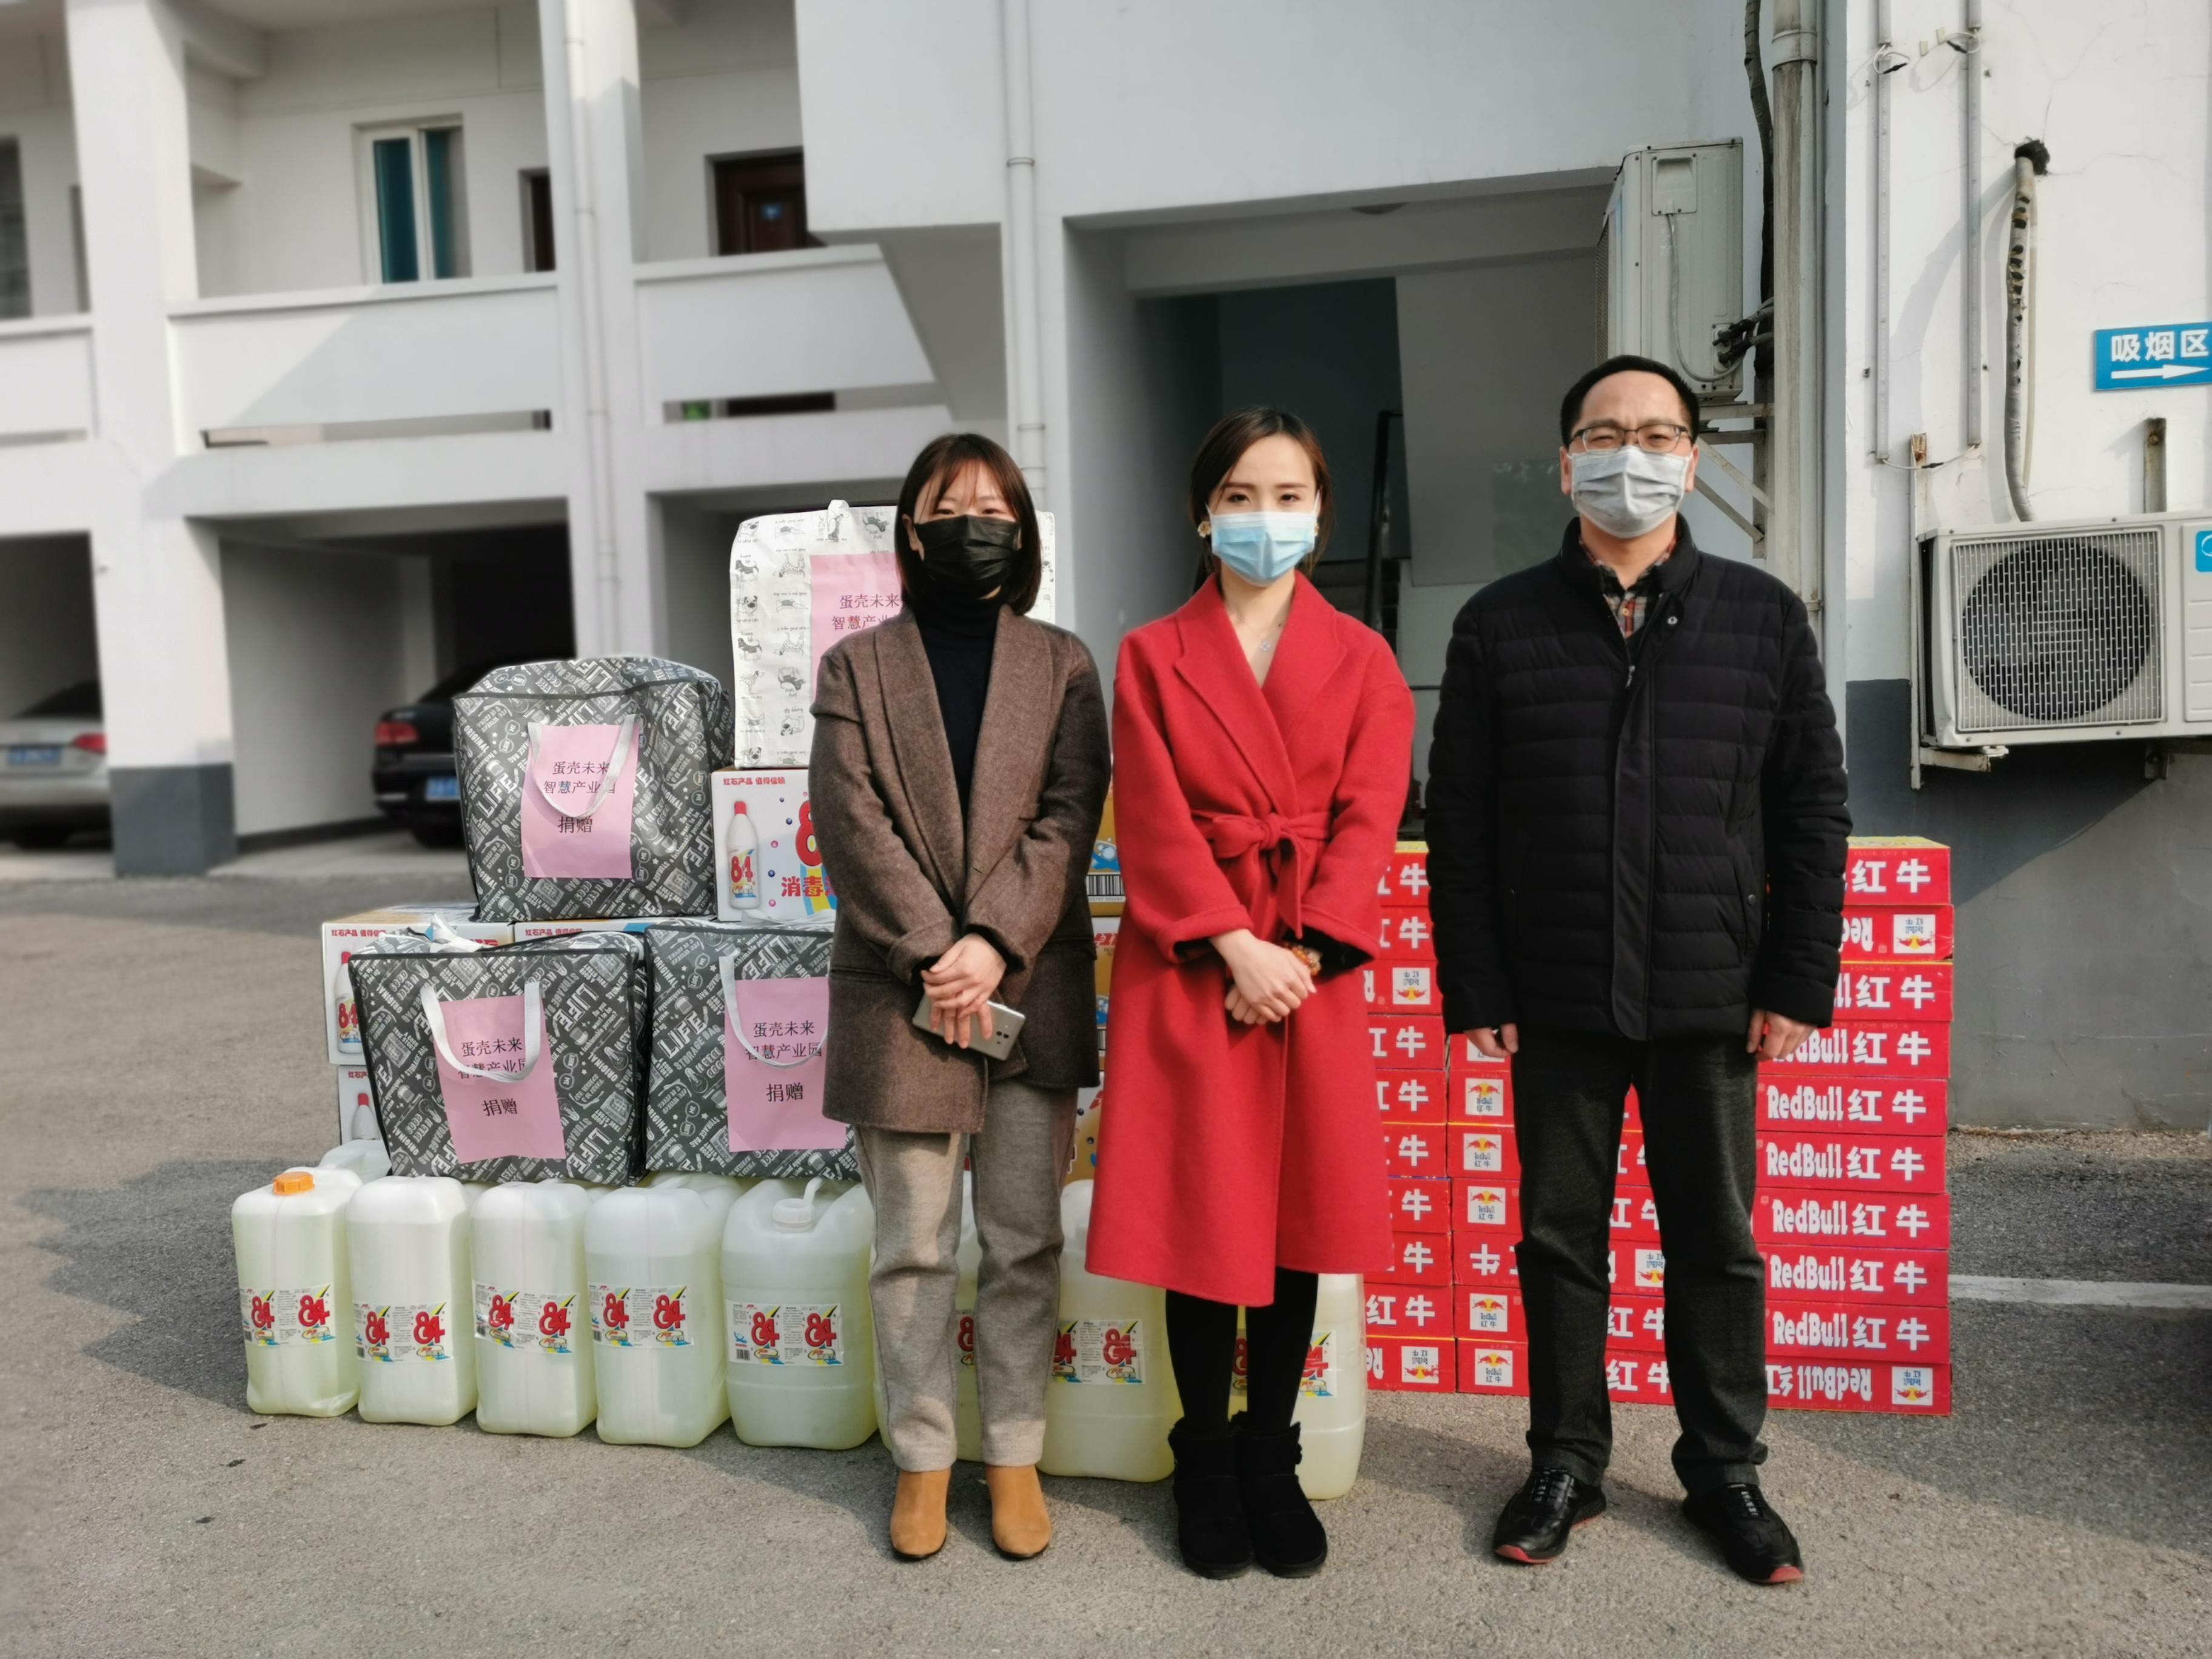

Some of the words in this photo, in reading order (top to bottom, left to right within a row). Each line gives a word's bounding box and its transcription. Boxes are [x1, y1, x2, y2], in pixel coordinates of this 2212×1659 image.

[2111, 329, 2210, 363] 吸烟区
[840, 593, 900, 609] 蛋壳未来
[833, 614, 896, 630] 智慧产业
[666, 683, 700, 731] LIFE
[463, 725, 490, 753] ORIGINAL
[552, 760, 610, 775] 蛋壳未来
[475, 773, 517, 819] LIFE
[558, 816, 593, 833] 捐赠
[730, 856, 754, 883] 84
[1377, 863, 1429, 896] 牛
[1851, 858, 1931, 894] 红牛
[653, 956, 679, 988] ORIGINAL
[743, 935, 792, 980] LIFE
[376, 983, 403, 1014] ORIGINAL
[551, 973, 580, 1010] STORAGE
[552, 982, 600, 1032] LIFE
[1855, 974, 1935, 1010] 红牛
[657, 1010, 707, 1059] LIFE
[753, 1020, 814, 1038] 蛋壳未来
[461, 1036, 523, 1057] 蛋壳未来
[673, 1036, 705, 1070] STORAGE
[745, 1042, 822, 1061] 智慧产业园
[1773, 1028, 1848, 1064] dBull
[1852, 1031, 1931, 1066] 红牛
[588, 1052, 618, 1082] ORIGINAL
[483, 1098, 517, 1116] 捐赠
[766, 1082, 803, 1102] 捐赠
[1766, 1085, 1843, 1121] RedBull
[1847, 1089, 1926, 1124] 红牛
[647, 1105, 671, 1136] ORIGINAL
[699, 1116, 720, 1141] STORAGE
[392, 1125, 419, 1156] ORIGINAL
[566, 1127, 612, 1175] LIFE
[689, 1136, 702, 1148] BAG
[1766, 1142, 1843, 1179] RedBull
[1846, 1146, 1925, 1181] 红牛
[1772, 1199, 1848, 1235] RedBull
[1851, 1203, 1929, 1238] 红牛
[1769, 1255, 1846, 1292] RedBull
[1849, 1259, 1928, 1294] 红牛
[252, 1296, 275, 1329] 84
[298, 1295, 330, 1327] 84
[366, 1311, 390, 1345] 84
[414, 1311, 446, 1344] 84
[489, 1295, 514, 1330] 84
[539, 1302, 571, 1336] 84
[603, 1293, 629, 1329] 84
[653, 1295, 686, 1329] 84
[1366, 1295, 1435, 1327] 红牛
[1607, 1305, 1664, 1340] 红牛
[751, 1312, 780, 1347] 84
[805, 1313, 837, 1347] 84
[1772, 1311, 1849, 1347] RedBull
[1852, 1316, 1929, 1352] 红牛
[1102, 1329, 1137, 1365] 84
[1606, 1358, 1670, 1393] 红牛
[1797, 1366, 1872, 1401] RedBull
